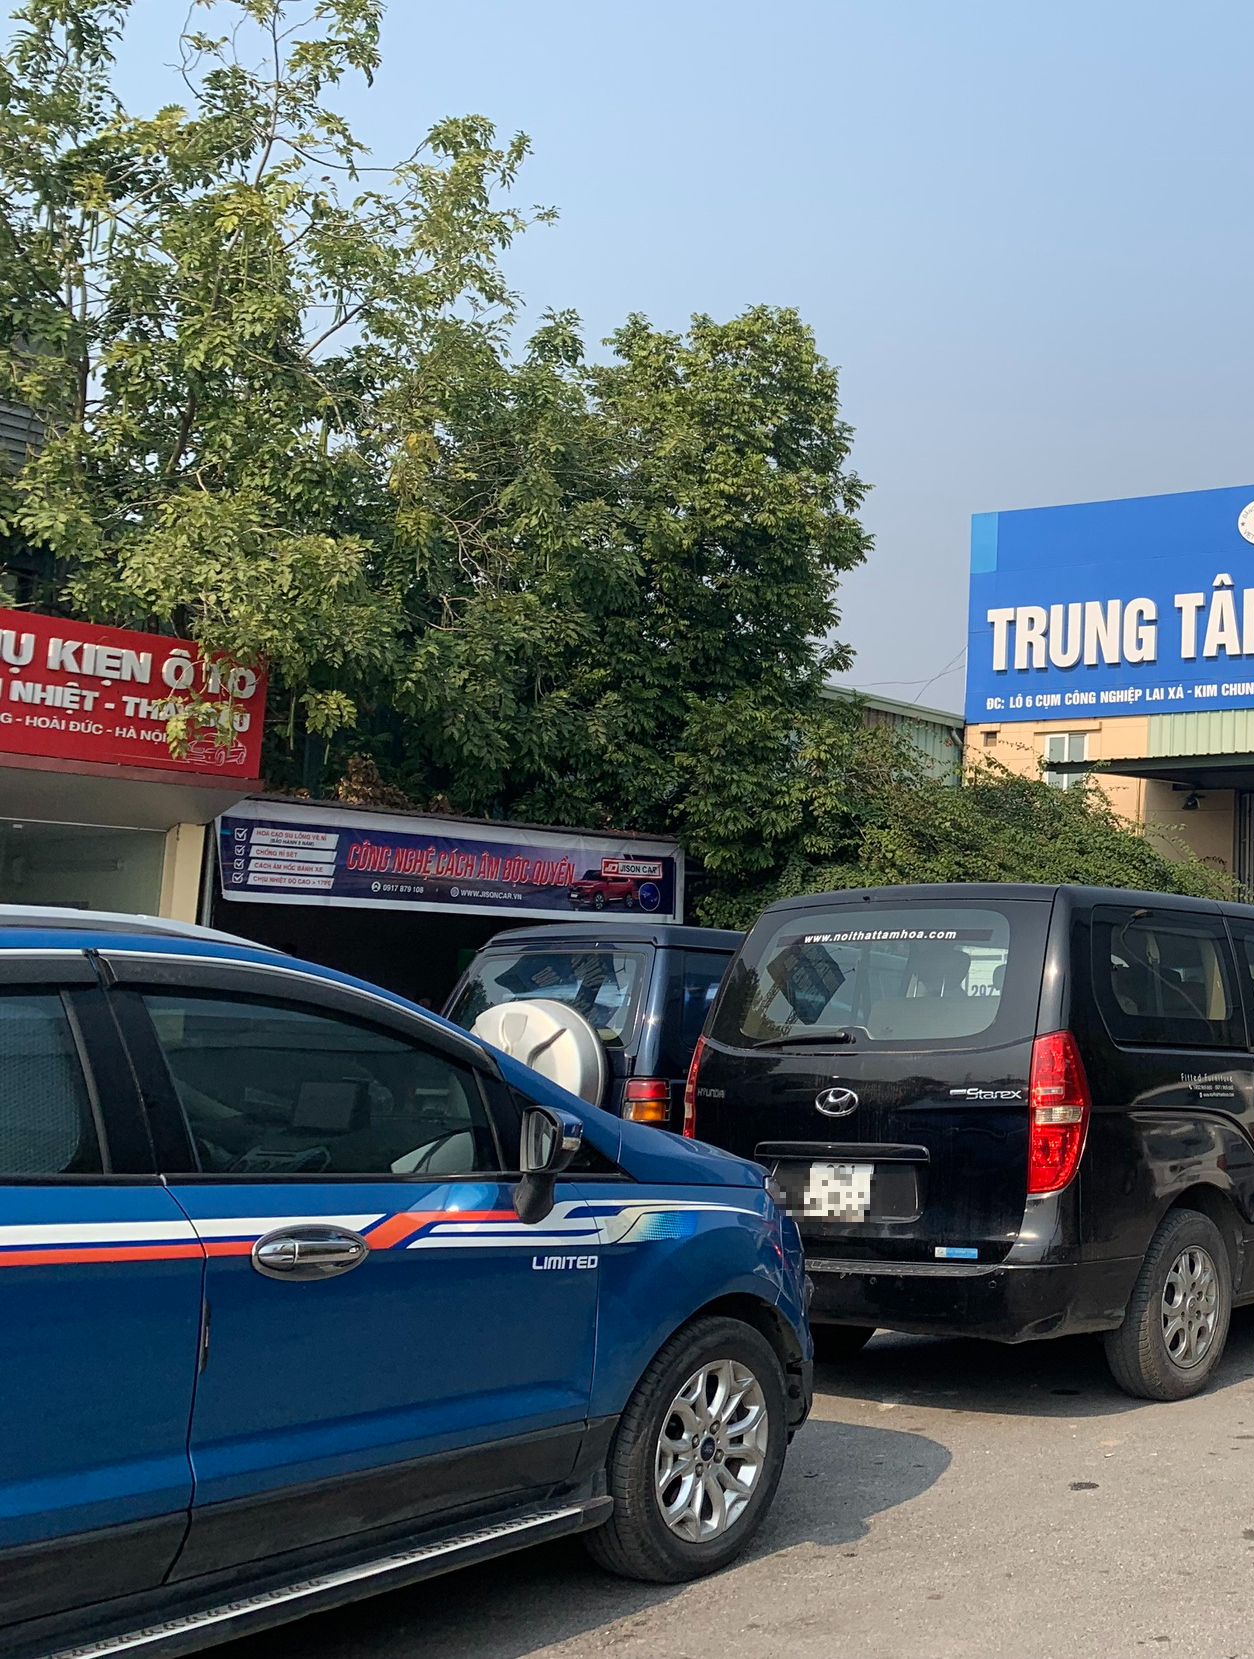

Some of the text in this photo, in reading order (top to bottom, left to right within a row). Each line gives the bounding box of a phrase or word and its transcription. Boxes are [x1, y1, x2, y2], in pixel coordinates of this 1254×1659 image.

[988, 597, 1157, 671] TRUNG
[0, 630, 36, 674] Ụ
[46, 637, 152, 686] KIỆN
[162, 648, 195, 690] Ô
[9, 680, 100, 715] NHIỆT
[986, 697, 1005, 710] ĐC:
[1009, 693, 1023, 708] LÔ
[1026, 695, 1033, 708] 6
[1035, 693, 1061, 709] CỤM
[1065, 689, 1096, 705] CÔNG
[1100, 686, 1143, 704] NGHIỆP
[1146, 687, 1164, 701] LAI
[1168, 684, 1184, 699] XÁ
[1194, 684, 1218, 698] KIM
[25, 715, 66, 730] HOÀI
[69, 719, 104, 735] ĐỨC
[115, 725, 137, 739] HÀ
[140, 729, 166, 744] NỘI
[346, 839, 575, 887] CÔNG NGHỆ CÁCH ÂM ĐỘC QUYỀN
[620, 864, 657, 874] JISON CAR
[804, 929, 957, 944] www.noithattamhoa.com
[966, 1087, 1022, 1100] Starex
[531, 1255, 599, 1270] LIMITED
